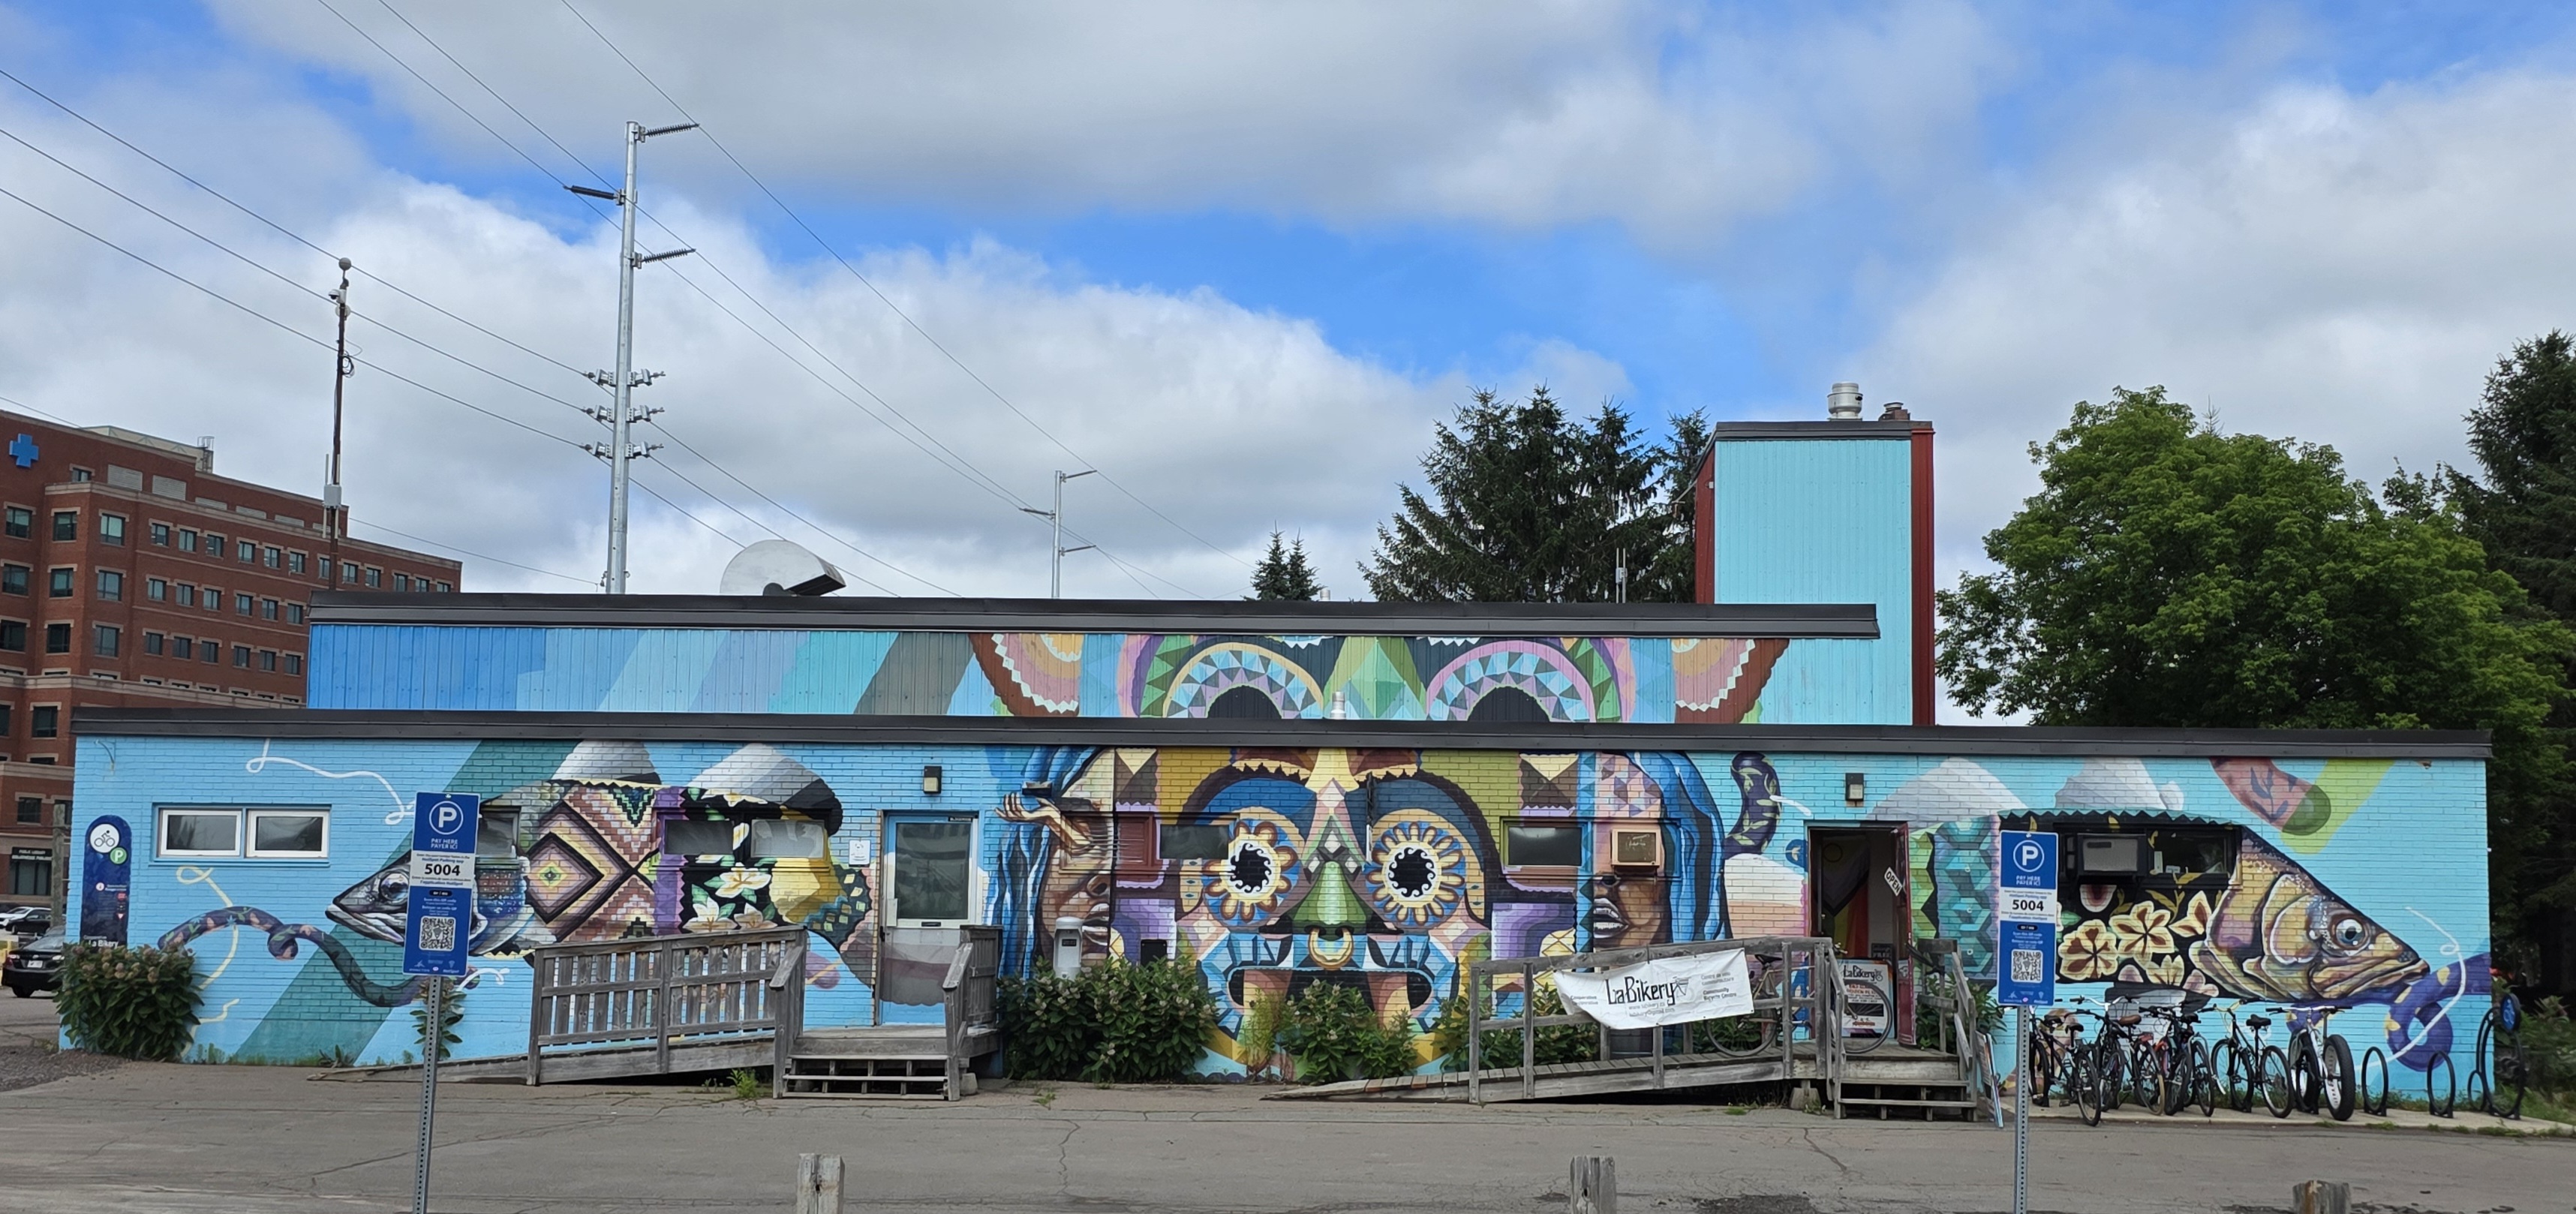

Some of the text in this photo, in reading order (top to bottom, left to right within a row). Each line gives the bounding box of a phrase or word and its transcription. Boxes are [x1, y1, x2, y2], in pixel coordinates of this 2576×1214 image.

[438, 807, 457, 828] P
[115, 850, 123, 862] P
[2022, 846, 2038, 866] P
[424, 864, 461, 876] 5004
[1886, 871, 1901, 893] OPEN
[2012, 900, 2044, 912] 5004
